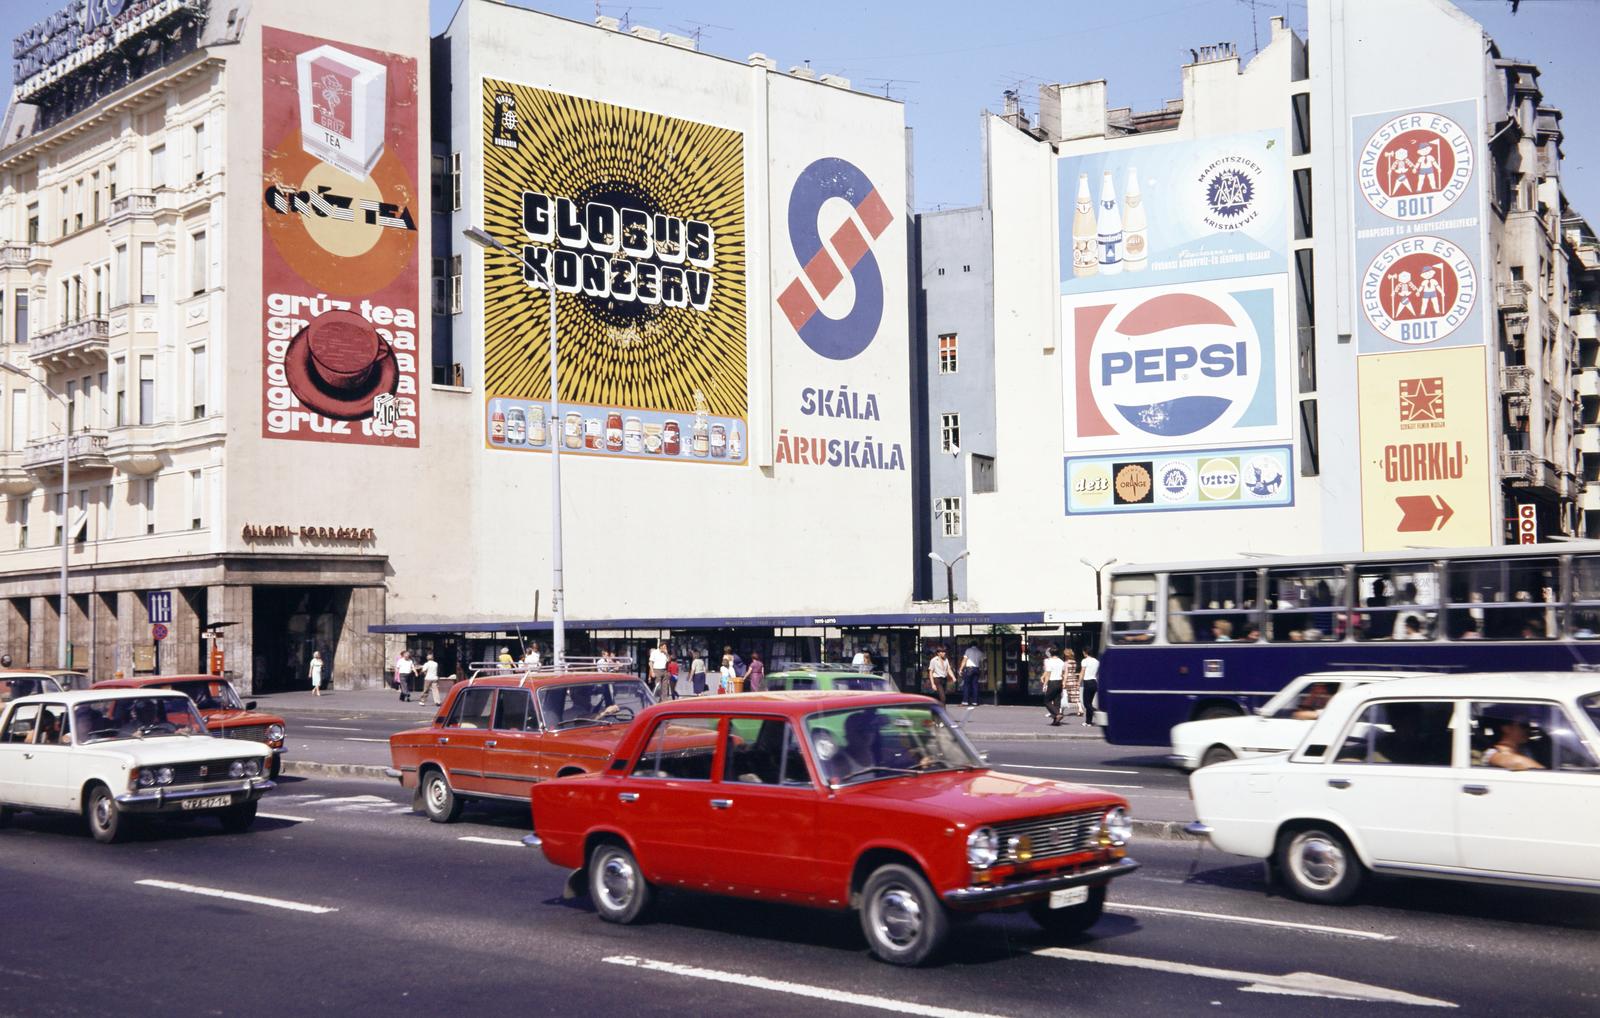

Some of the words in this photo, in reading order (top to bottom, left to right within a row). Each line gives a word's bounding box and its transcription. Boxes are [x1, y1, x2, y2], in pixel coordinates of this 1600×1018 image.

[325, 132, 341, 149] TEA
[1361, 116, 1422, 208] EZERMESTER
[360, 198, 417, 231] TEA
[1397, 196, 1434, 217] BOLT
[522, 191, 715, 270] GLOBUS
[522, 245, 714, 312] KONZERV
[1364, 239, 1424, 331] EZERMESTER
[360, 300, 416, 328] tea
[1401, 320, 1437, 341] BOLT
[1101, 341, 1248, 386] PEPSI
[1384, 440, 1463, 483] GORKIJ
